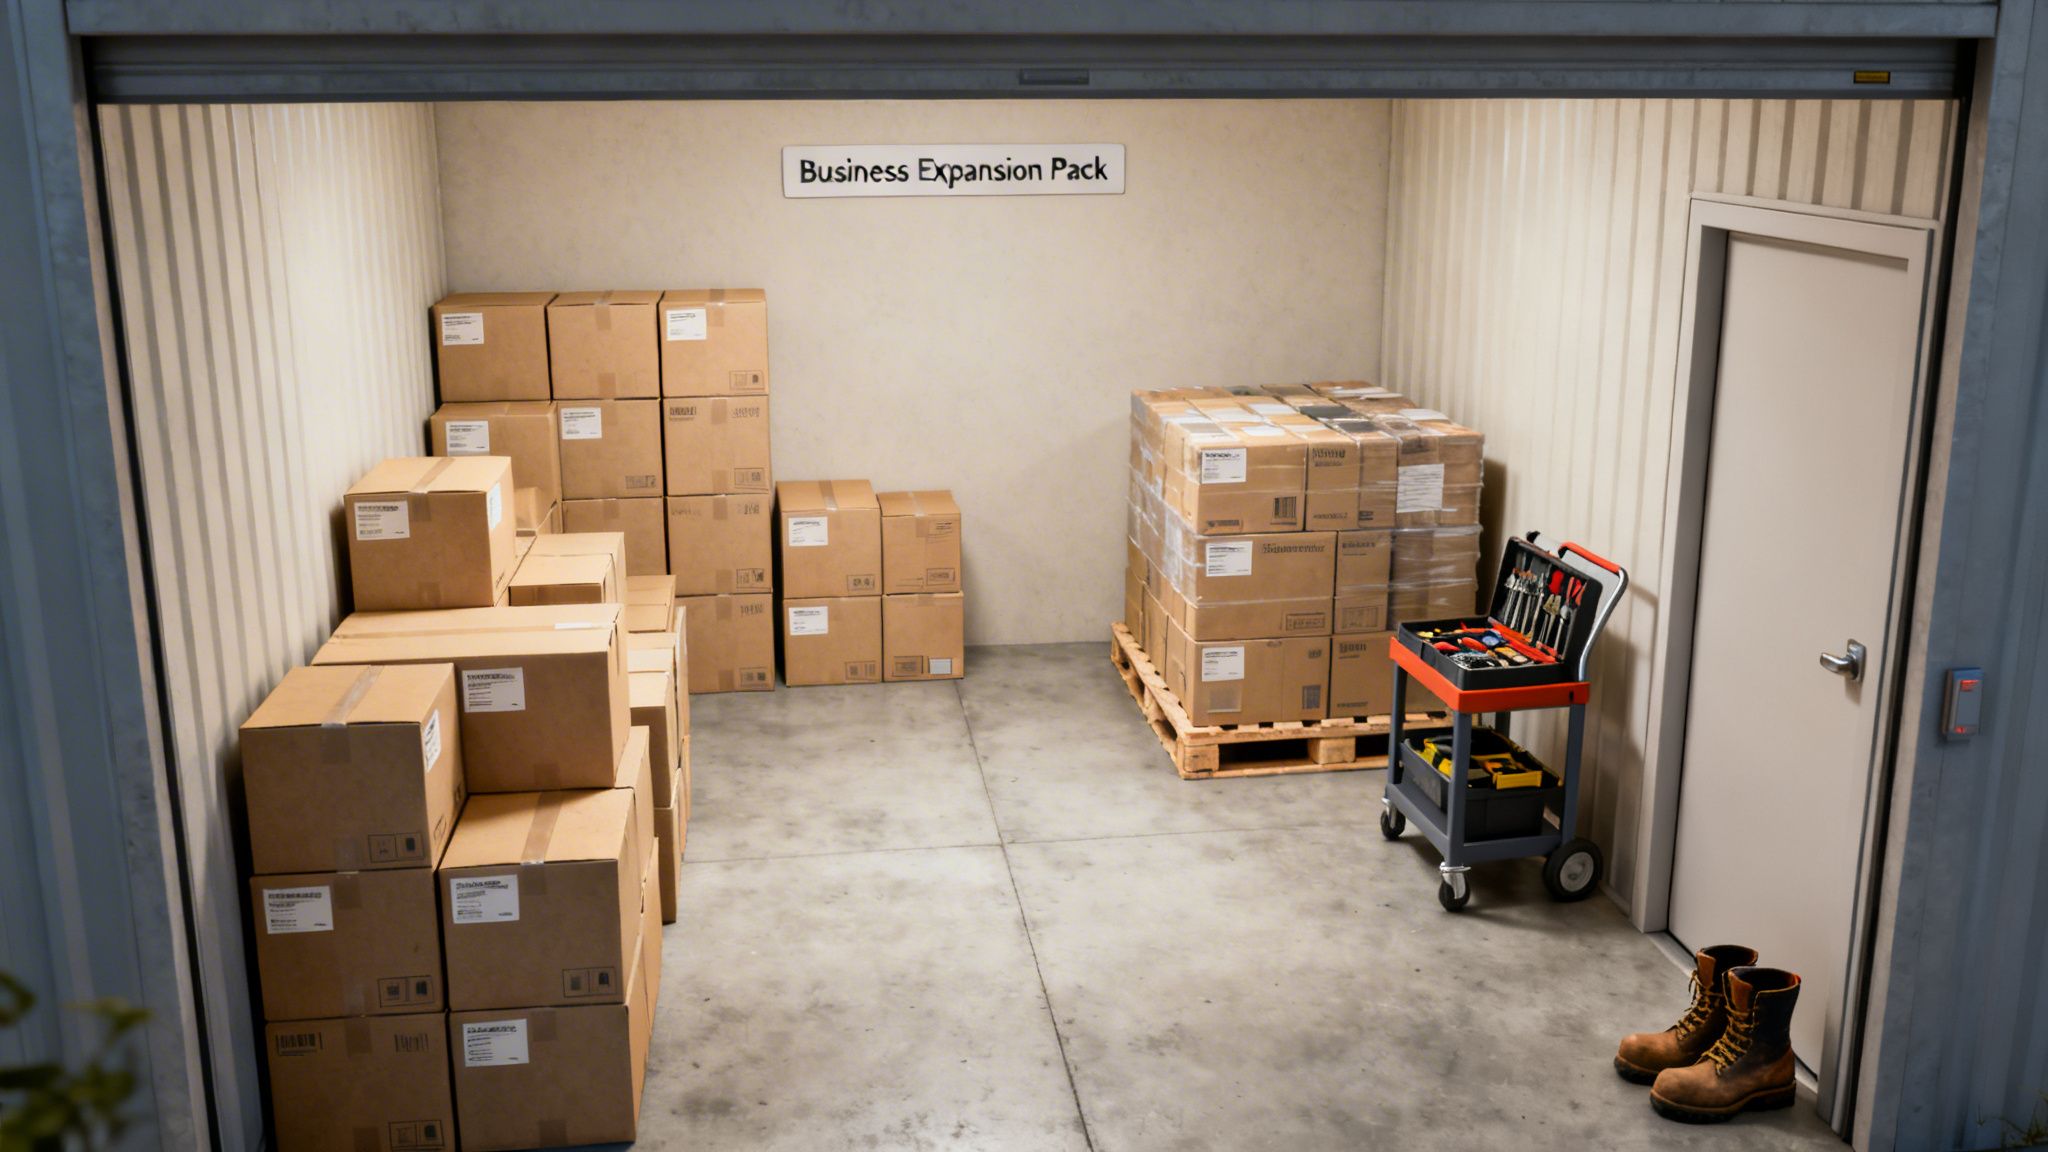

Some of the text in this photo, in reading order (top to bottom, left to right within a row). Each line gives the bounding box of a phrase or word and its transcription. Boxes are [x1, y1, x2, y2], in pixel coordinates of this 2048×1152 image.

[801, 155, 1107, 189] Business Expansion Pack
